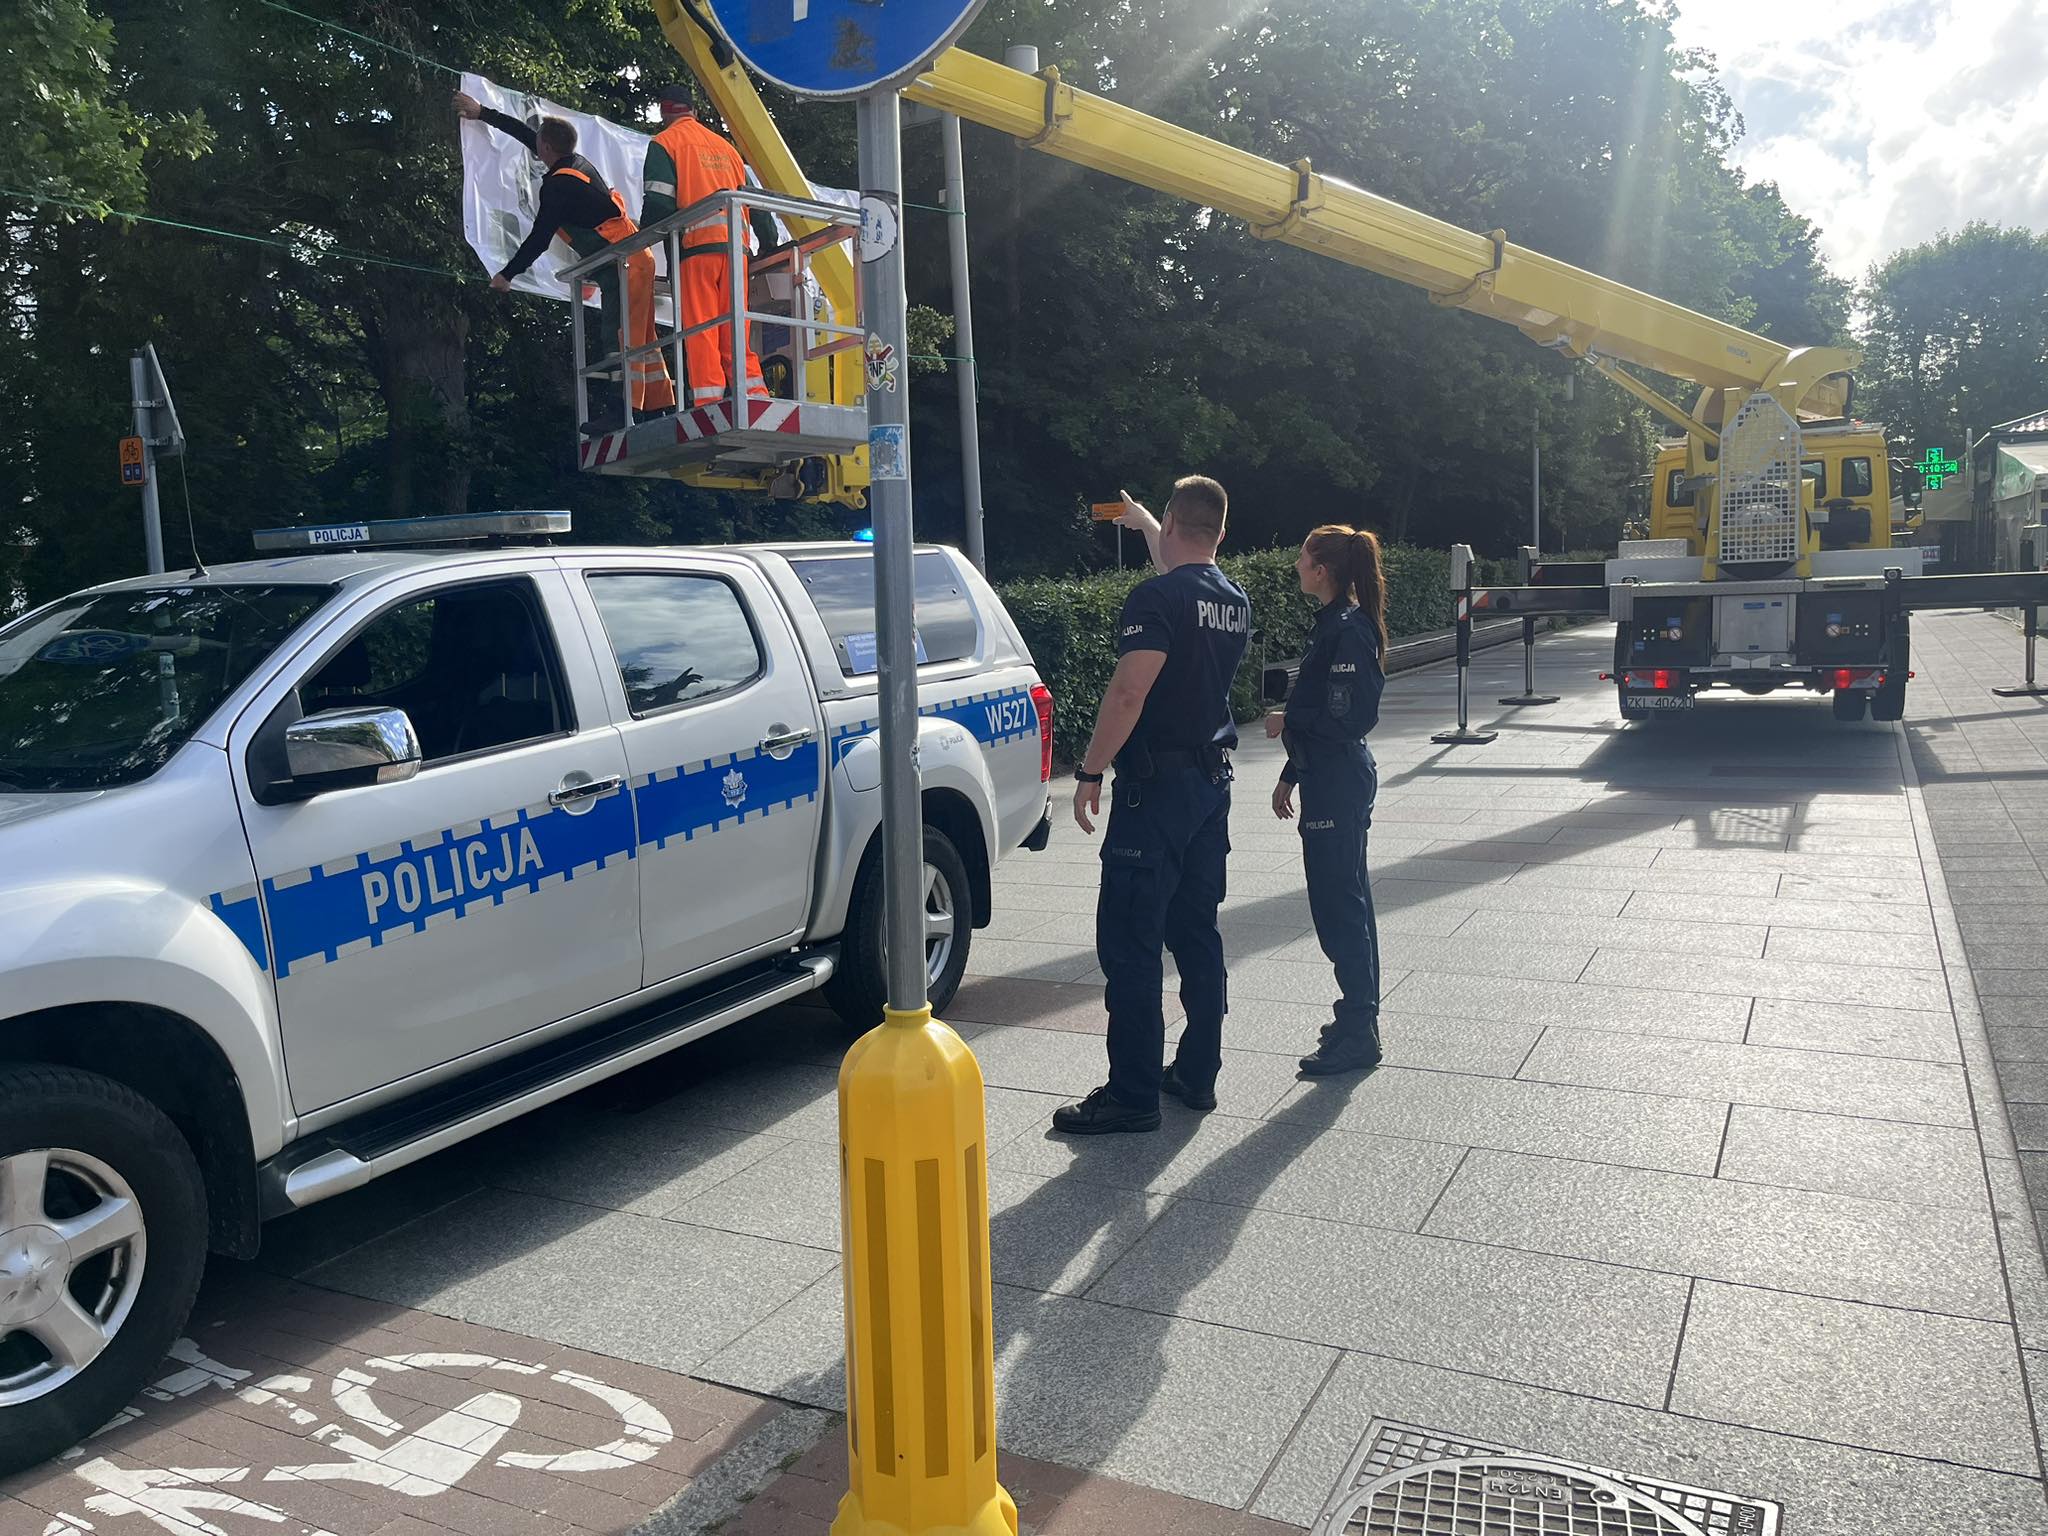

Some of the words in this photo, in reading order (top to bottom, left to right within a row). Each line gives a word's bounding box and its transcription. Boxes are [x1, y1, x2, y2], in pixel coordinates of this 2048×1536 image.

[314, 528, 363, 543] POLICJA
[1196, 600, 1247, 633] POLICJA
[984, 698, 1028, 735] W527
[1305, 819, 1335, 830] POLICJA
[361, 826, 545, 925] POLICJA
